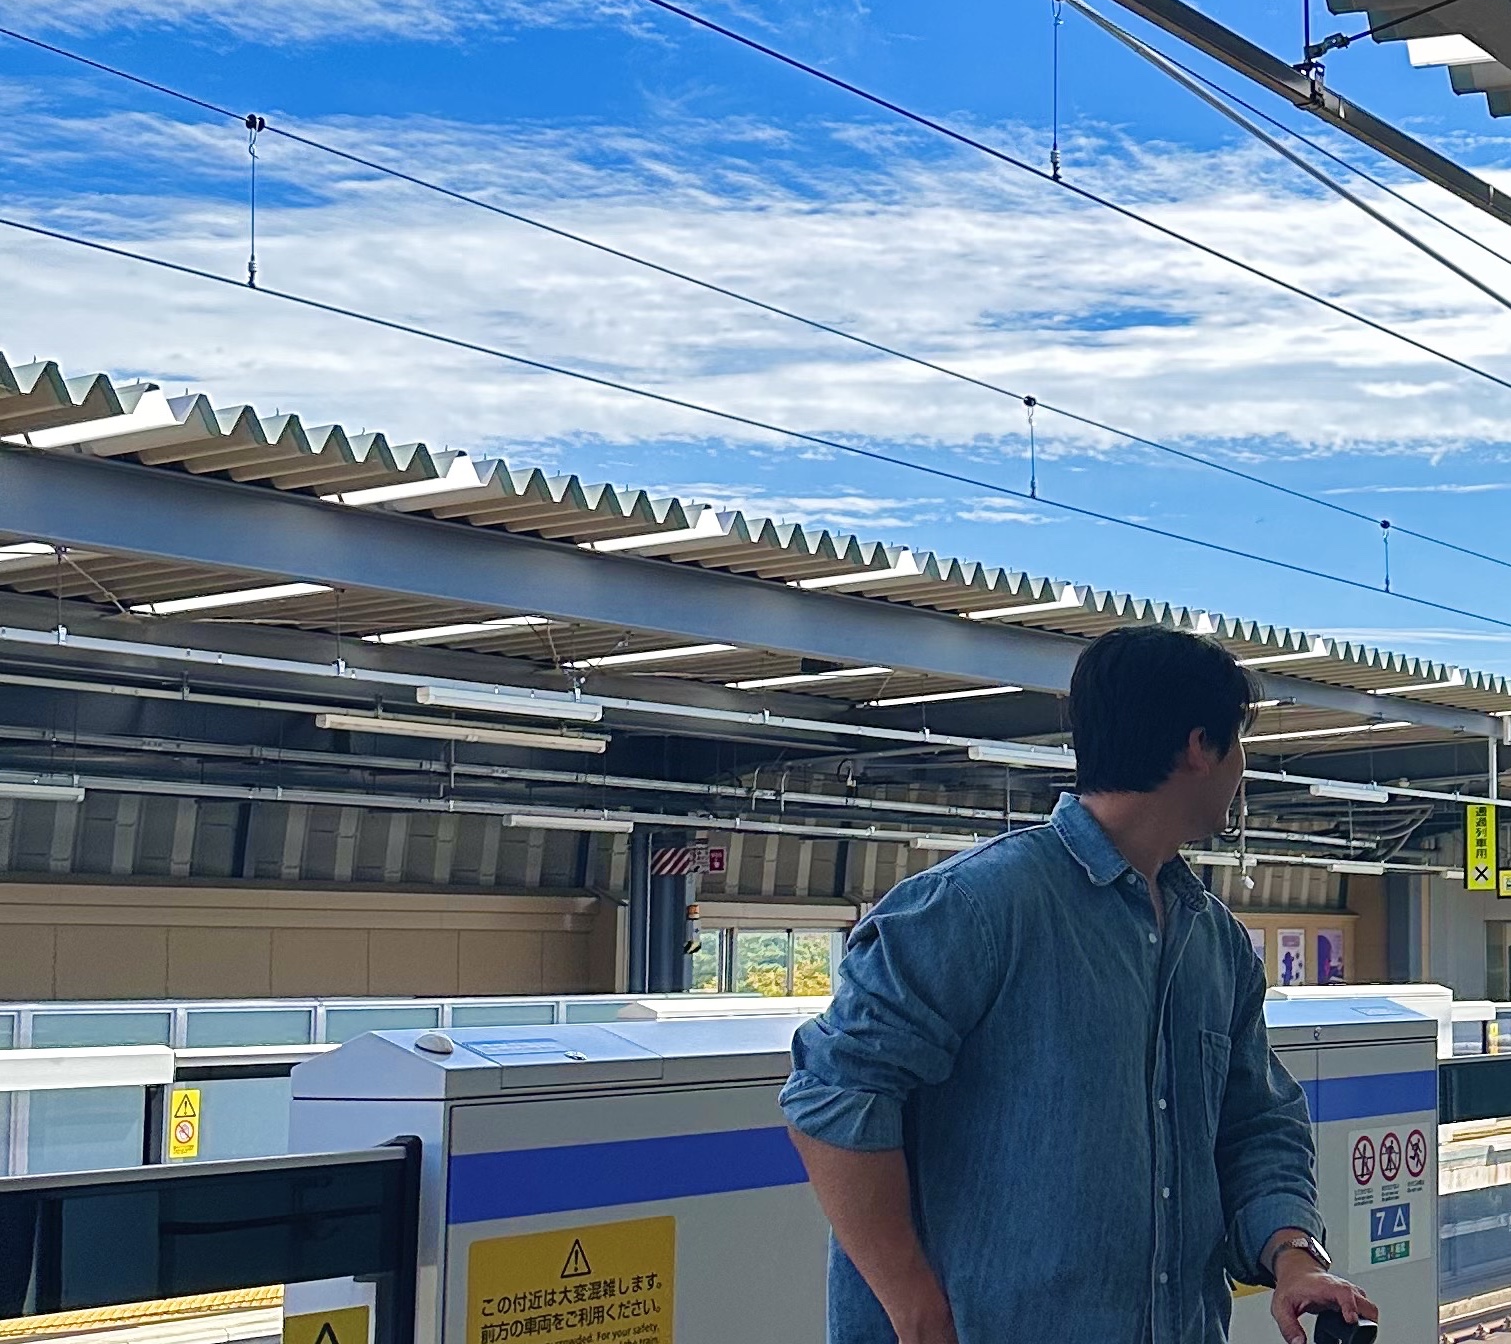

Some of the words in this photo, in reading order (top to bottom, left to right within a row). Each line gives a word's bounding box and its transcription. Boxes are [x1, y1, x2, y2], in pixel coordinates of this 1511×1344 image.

[481, 1272, 662, 1317] この付近は大変混雑します。
[481, 1298, 662, 1344] 前方の車両をご利用ください。
[596, 1330, 610, 1342] For
[611, 1327, 631, 1341] your
